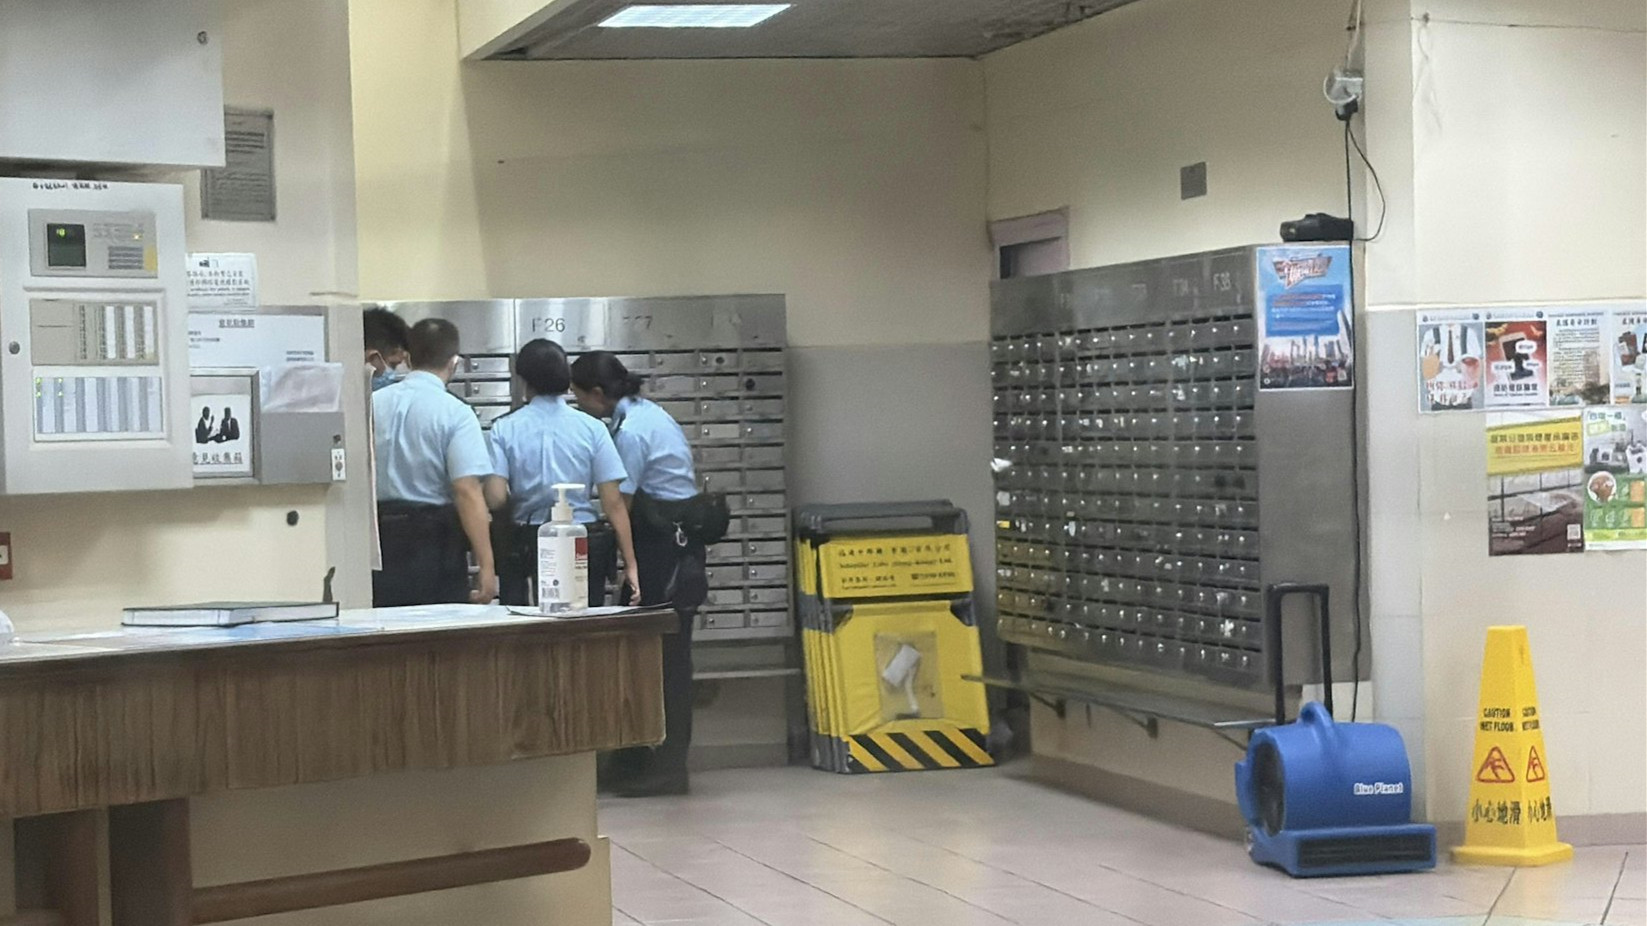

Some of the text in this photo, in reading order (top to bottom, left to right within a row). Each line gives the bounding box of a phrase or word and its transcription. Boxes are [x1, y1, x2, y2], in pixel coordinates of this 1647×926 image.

[531, 317, 566, 333] F26
[1483, 707, 1511, 718] CAUTION
[1480, 721, 1514, 732] WET FLOOR
[1353, 782, 1404, 795] Blue Planet
[1472, 798, 1521, 824] 小心地滑
